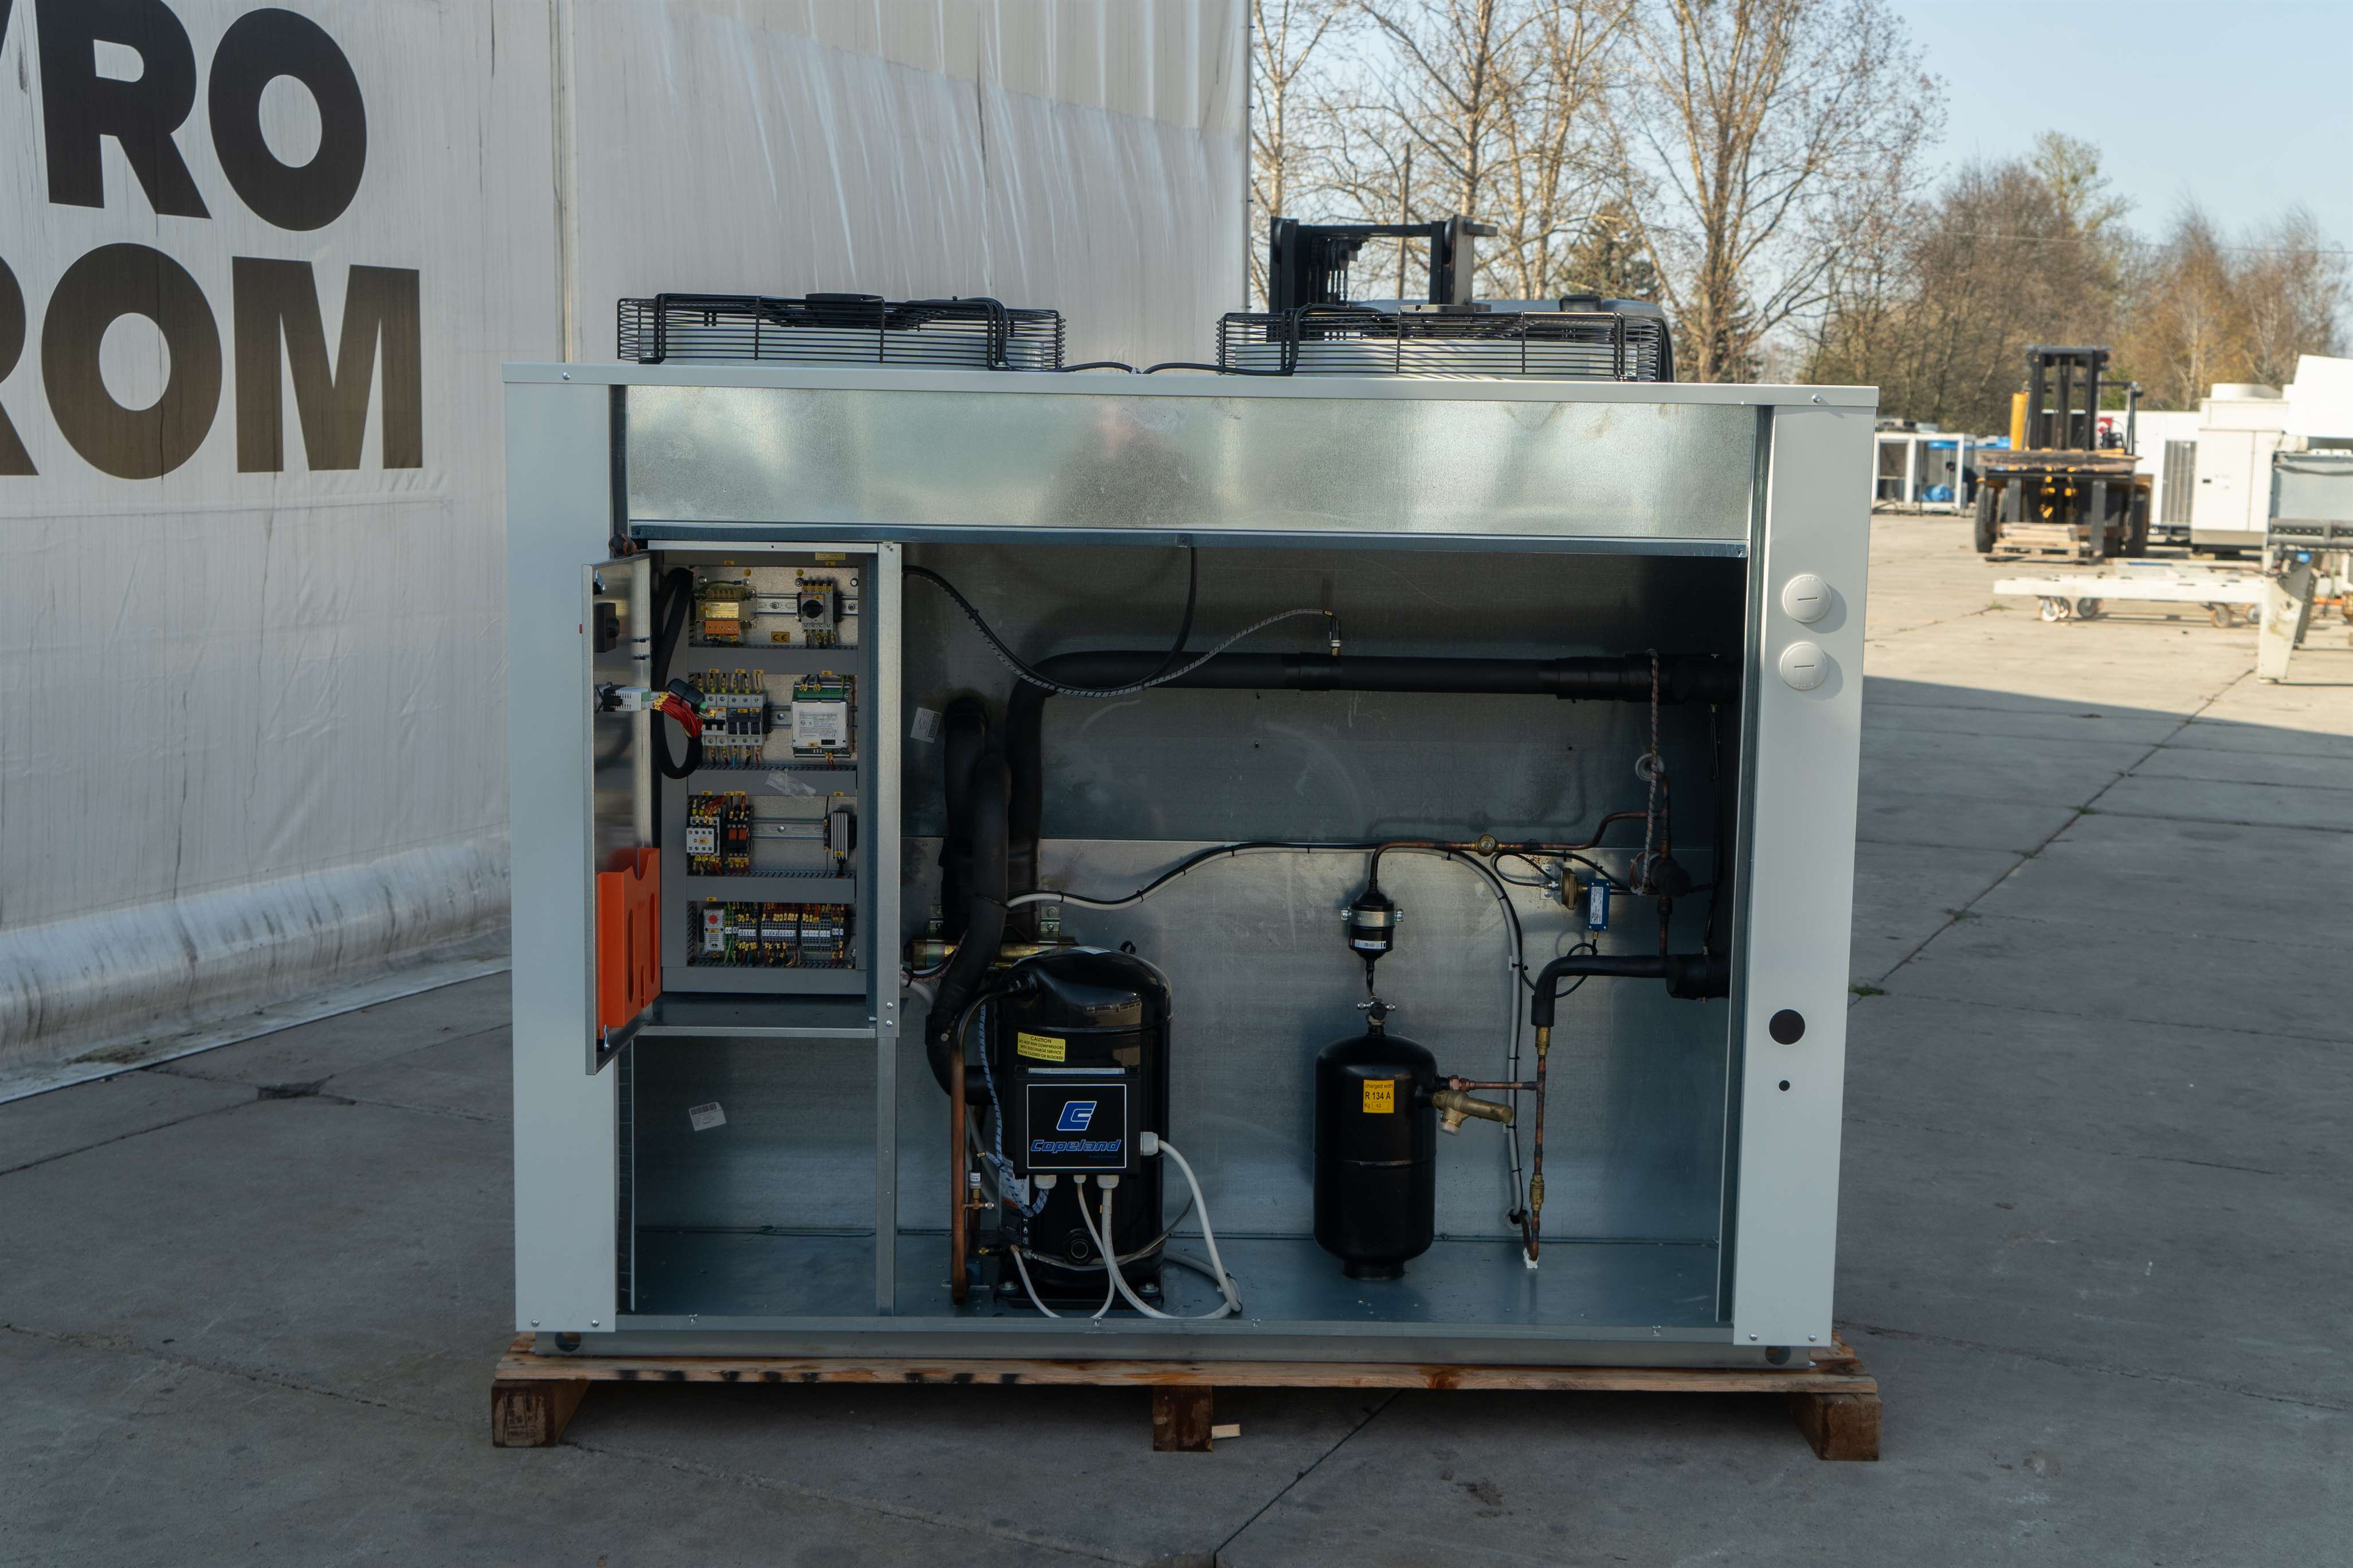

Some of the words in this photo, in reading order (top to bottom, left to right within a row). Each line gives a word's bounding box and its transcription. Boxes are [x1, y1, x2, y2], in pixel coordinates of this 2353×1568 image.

[0, 0, 367, 231] RO
[0, 242, 423, 480] OM
[1030, 1139, 1121, 1154] Copeland
[1365, 1091, 1370, 1099] R
[1372, 1091, 1384, 1100] 134
[1386, 1091, 1391, 1099] A
